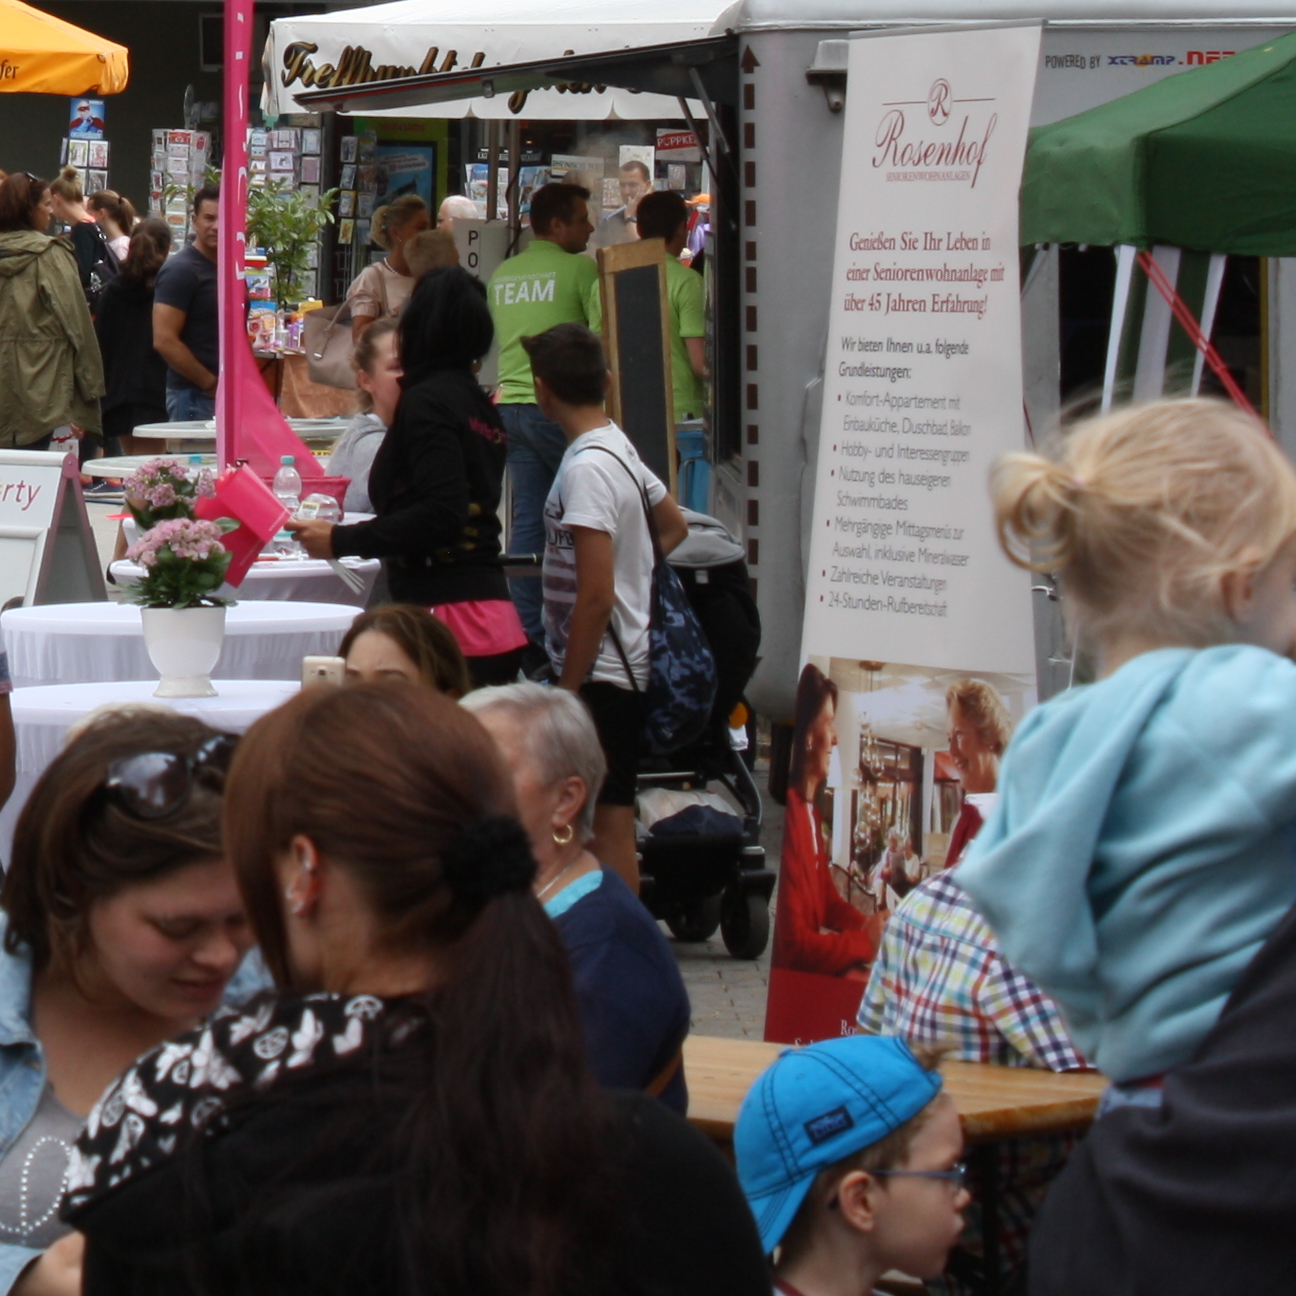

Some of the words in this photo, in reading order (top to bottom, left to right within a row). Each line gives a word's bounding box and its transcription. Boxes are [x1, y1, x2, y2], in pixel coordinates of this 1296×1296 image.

[1046, 55, 1086, 69] POWERED
[1090, 54, 1101, 69] BY
[872, 109, 997, 189] Rosenhof
[849, 231, 896, 252] Genießen
[900, 231, 919, 251] Sie
[923, 231, 943, 251] Ihr
[946, 231, 979, 251] Leben
[982, 231, 991, 251] in
[846, 262, 871, 282] einer
[873, 262, 988, 289] Seniorenwohnanlage
[990, 262, 1005, 282] mit
[494, 280, 555, 305] TEAM
[844, 292, 867, 311] über
[868, 292, 882, 311] 45
[884, 292, 926, 316] Jahren
[931, 293, 988, 320] Erfahrung!
[841, 337, 857, 352] Wir
[858, 337, 883, 352] bieten
[886, 337, 913, 353] Ihnen
[916, 342, 932, 354] u.a.
[935, 338, 969, 359] folgende
[838, 361, 912, 383] Grundleistungen:
[846, 390, 947, 411] Komfort-Appartement
[948, 396, 960, 410] mit
[841, 441, 872, 460] Hobby-
[875, 443, 894, 459] und
[897, 444, 969, 466] Interessengruppen
[839, 466, 875, 487] Nutzung
[878, 468, 895, 484] des
[898, 470, 951, 491] hauseigenen
[836, 490, 908, 510] Schwimmbades
[834, 516, 893, 540] Mehrgängige
[952, 528, 964, 540] zur
[832, 542, 872, 561] Auswahl,
[874, 545, 915, 563] inklusive
[918, 547, 969, 567] Mineralwasser
[830, 566, 879, 586] Zahlreiche
[881, 570, 947, 595] Veranstaltungen
